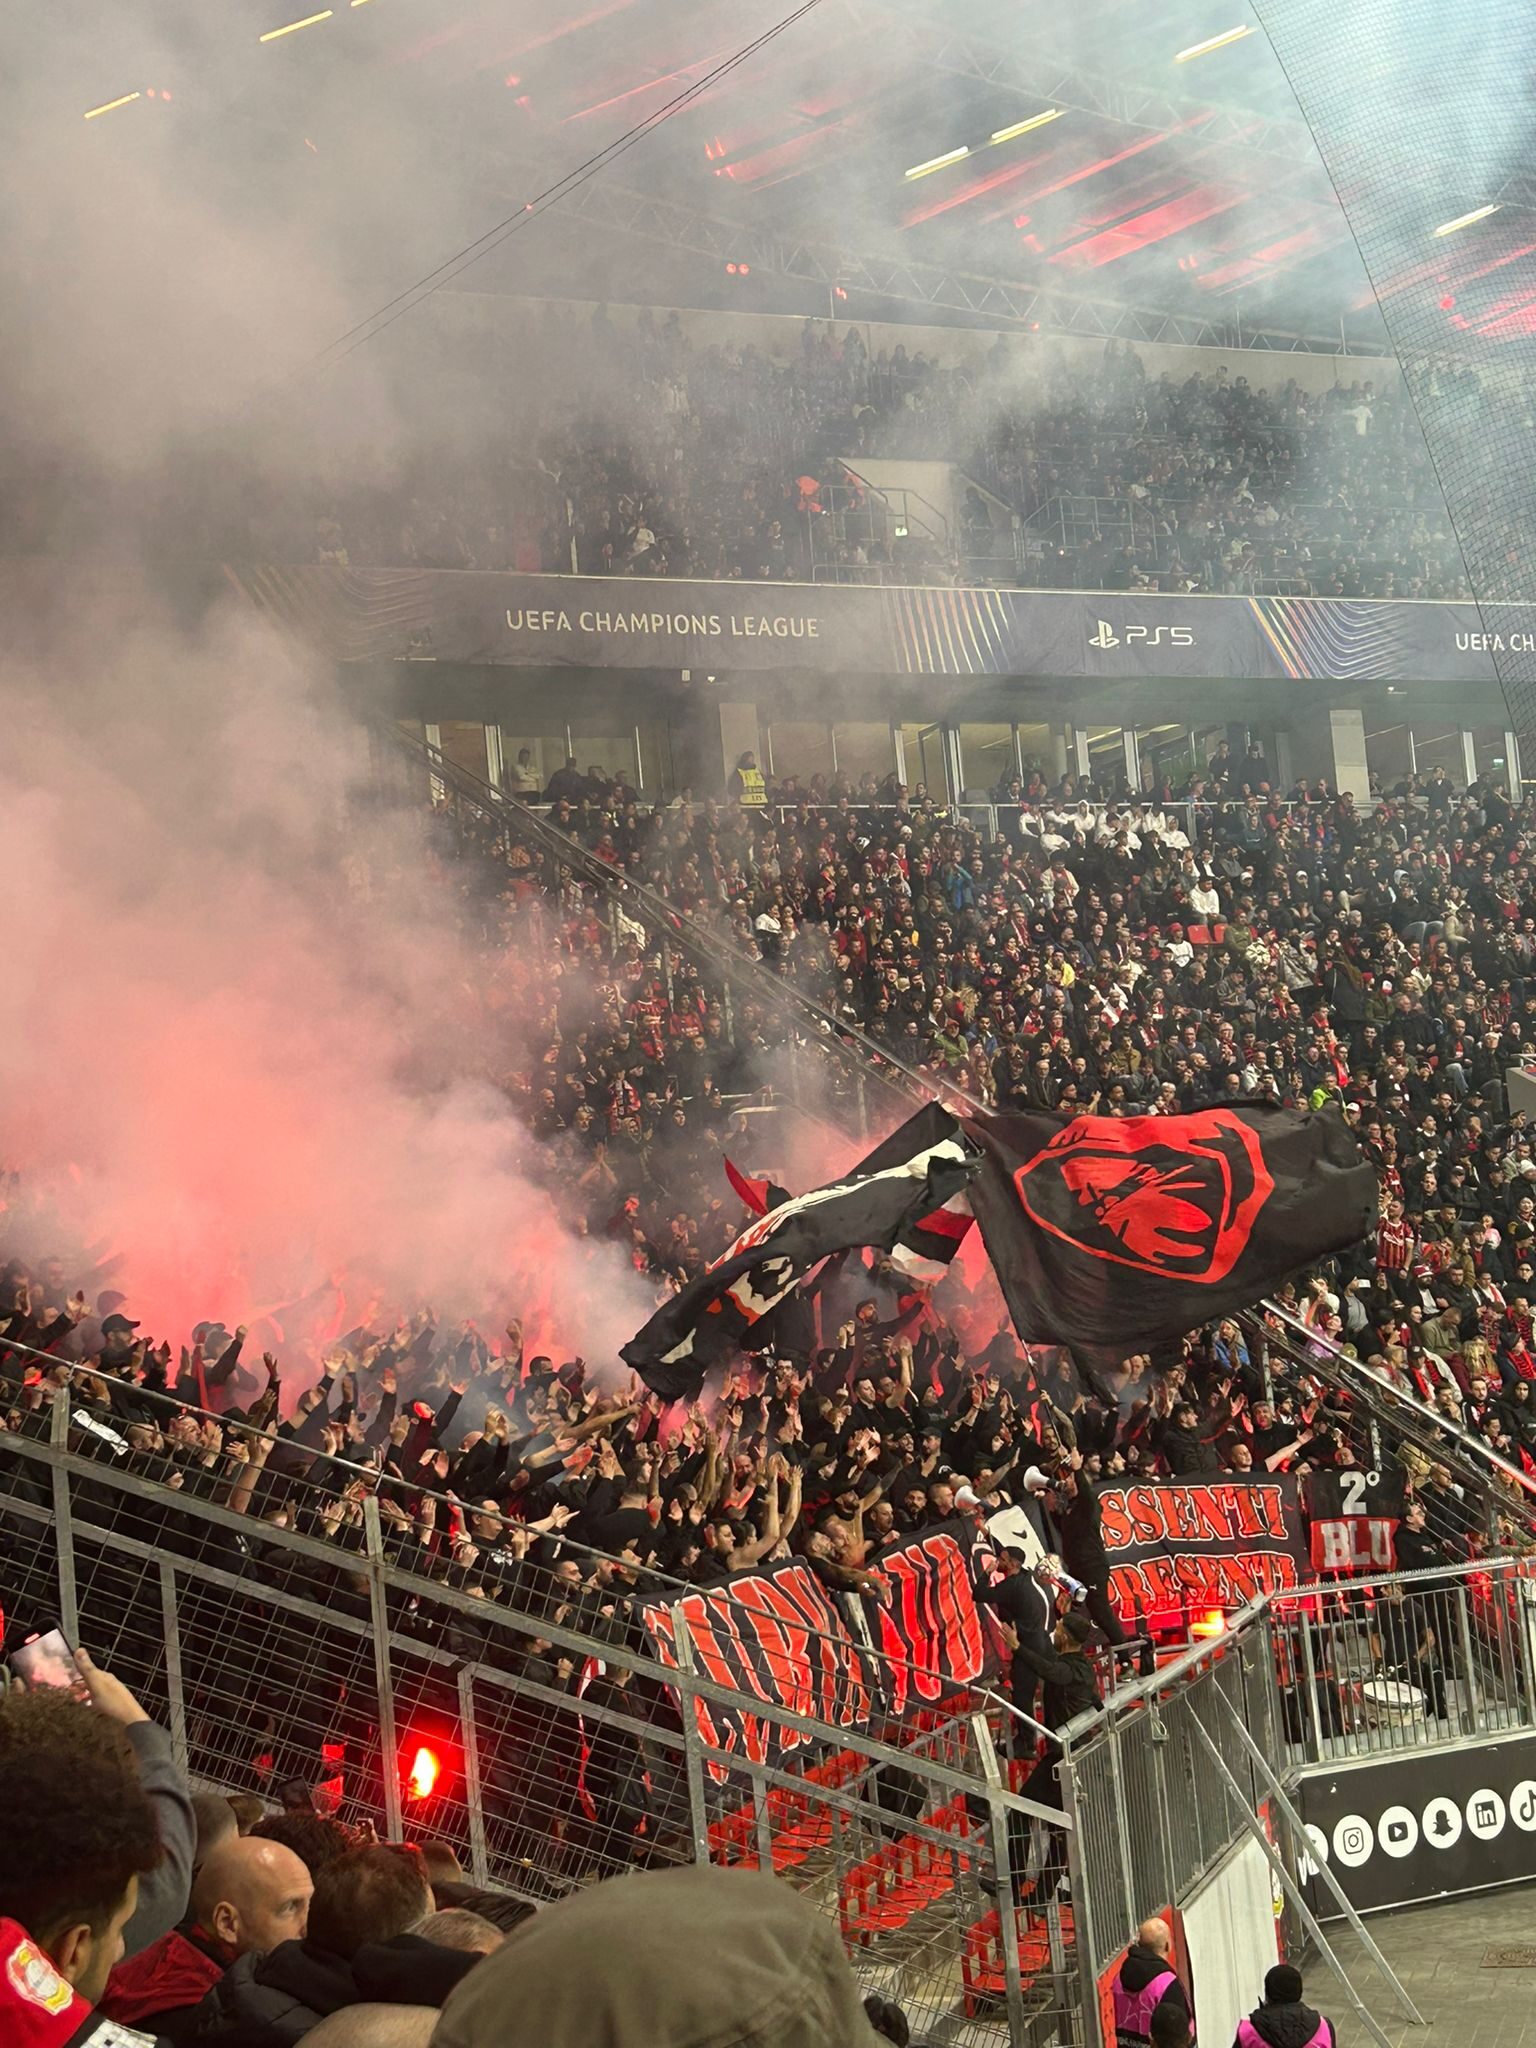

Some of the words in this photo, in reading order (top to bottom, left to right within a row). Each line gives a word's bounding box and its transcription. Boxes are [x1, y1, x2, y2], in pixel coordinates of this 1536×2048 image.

[506, 609, 572, 631] UEFA
[579, 611, 721, 635] CHAMPIONS
[731, 615, 819, 637] LEAGUE
[1125, 625, 1194, 646] PS5
[1455, 633, 1505, 651] UEFA
[1321, 1520, 1391, 1568] BLU
[1107, 1551, 1299, 1621] RESENTI
